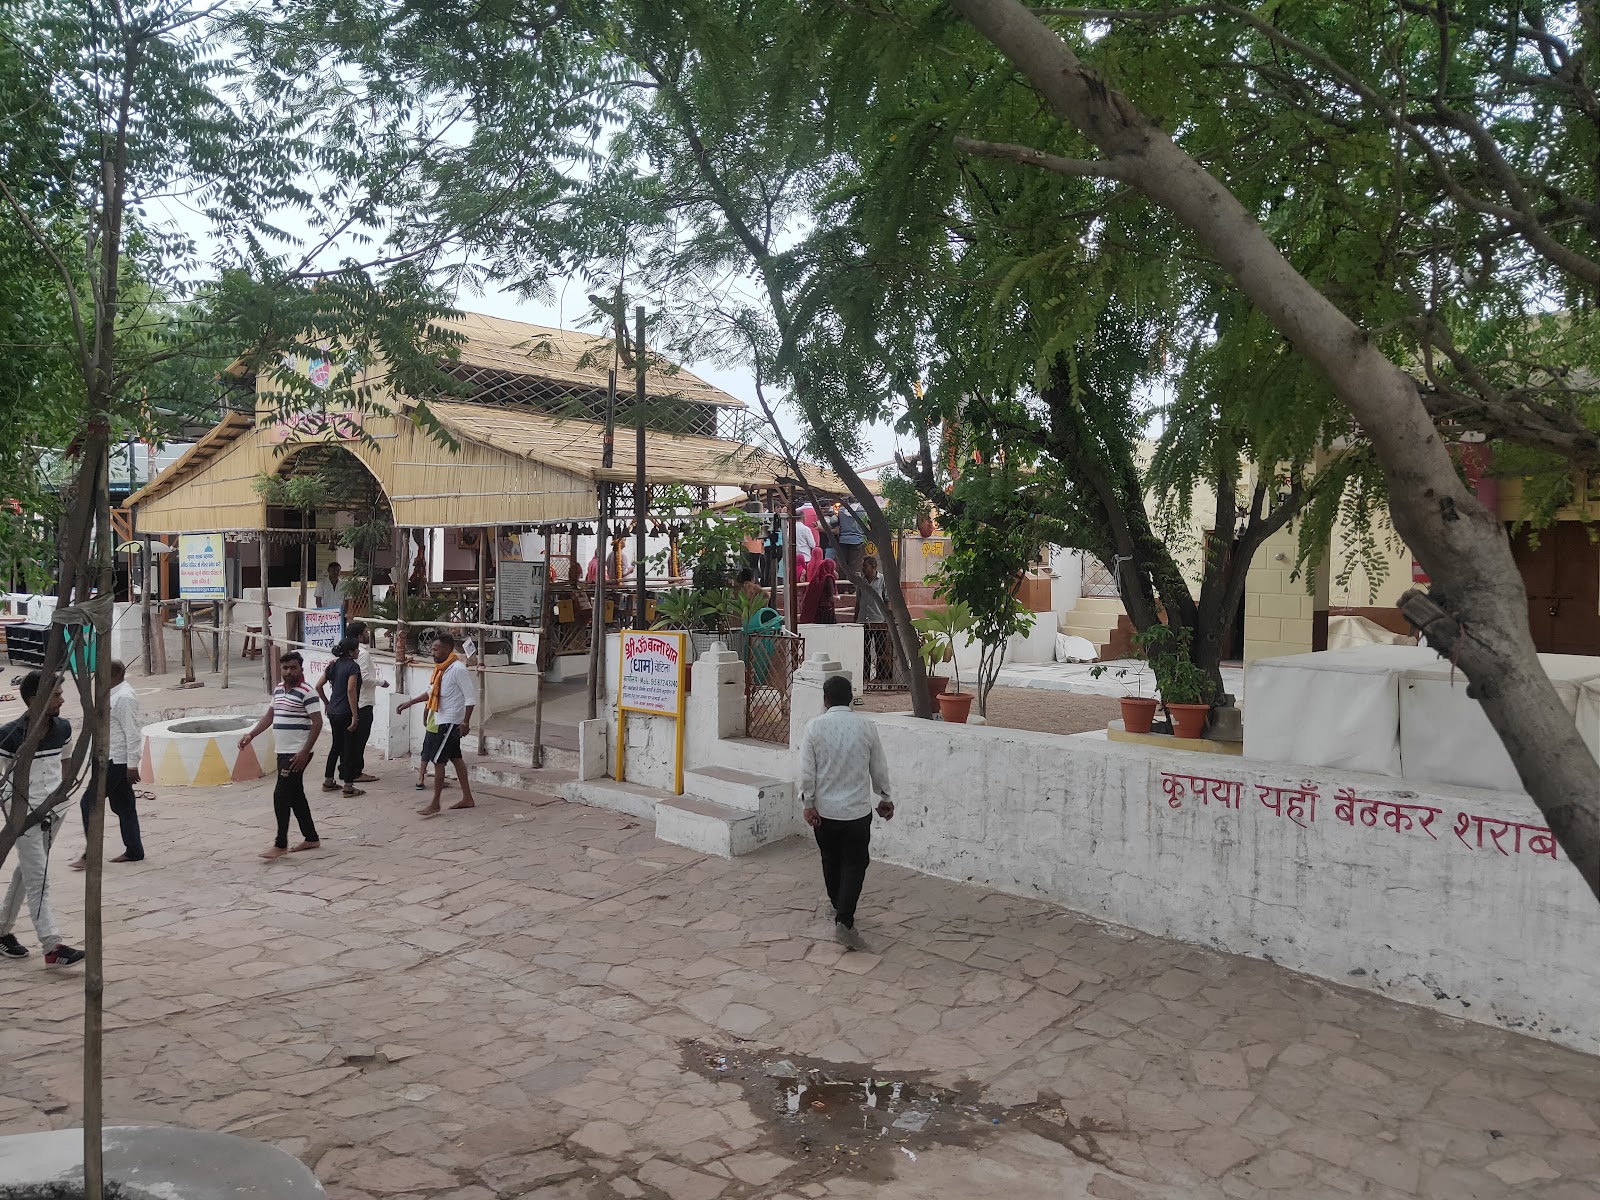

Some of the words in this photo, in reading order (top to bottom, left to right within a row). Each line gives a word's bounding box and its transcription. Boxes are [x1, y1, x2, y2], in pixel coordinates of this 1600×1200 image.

[516, 639, 536, 656] निकास
[625, 637, 635, 660] श्री
[636, 635, 647, 653] ॐ
[630, 658, 654, 675] (धाम)
[1160, 771, 1244, 810] कृपया
[1255, 783, 1321, 829] यहाँ
[1334, 787, 1443, 841] बैठकर
[1454, 811, 1558, 861] शराब
